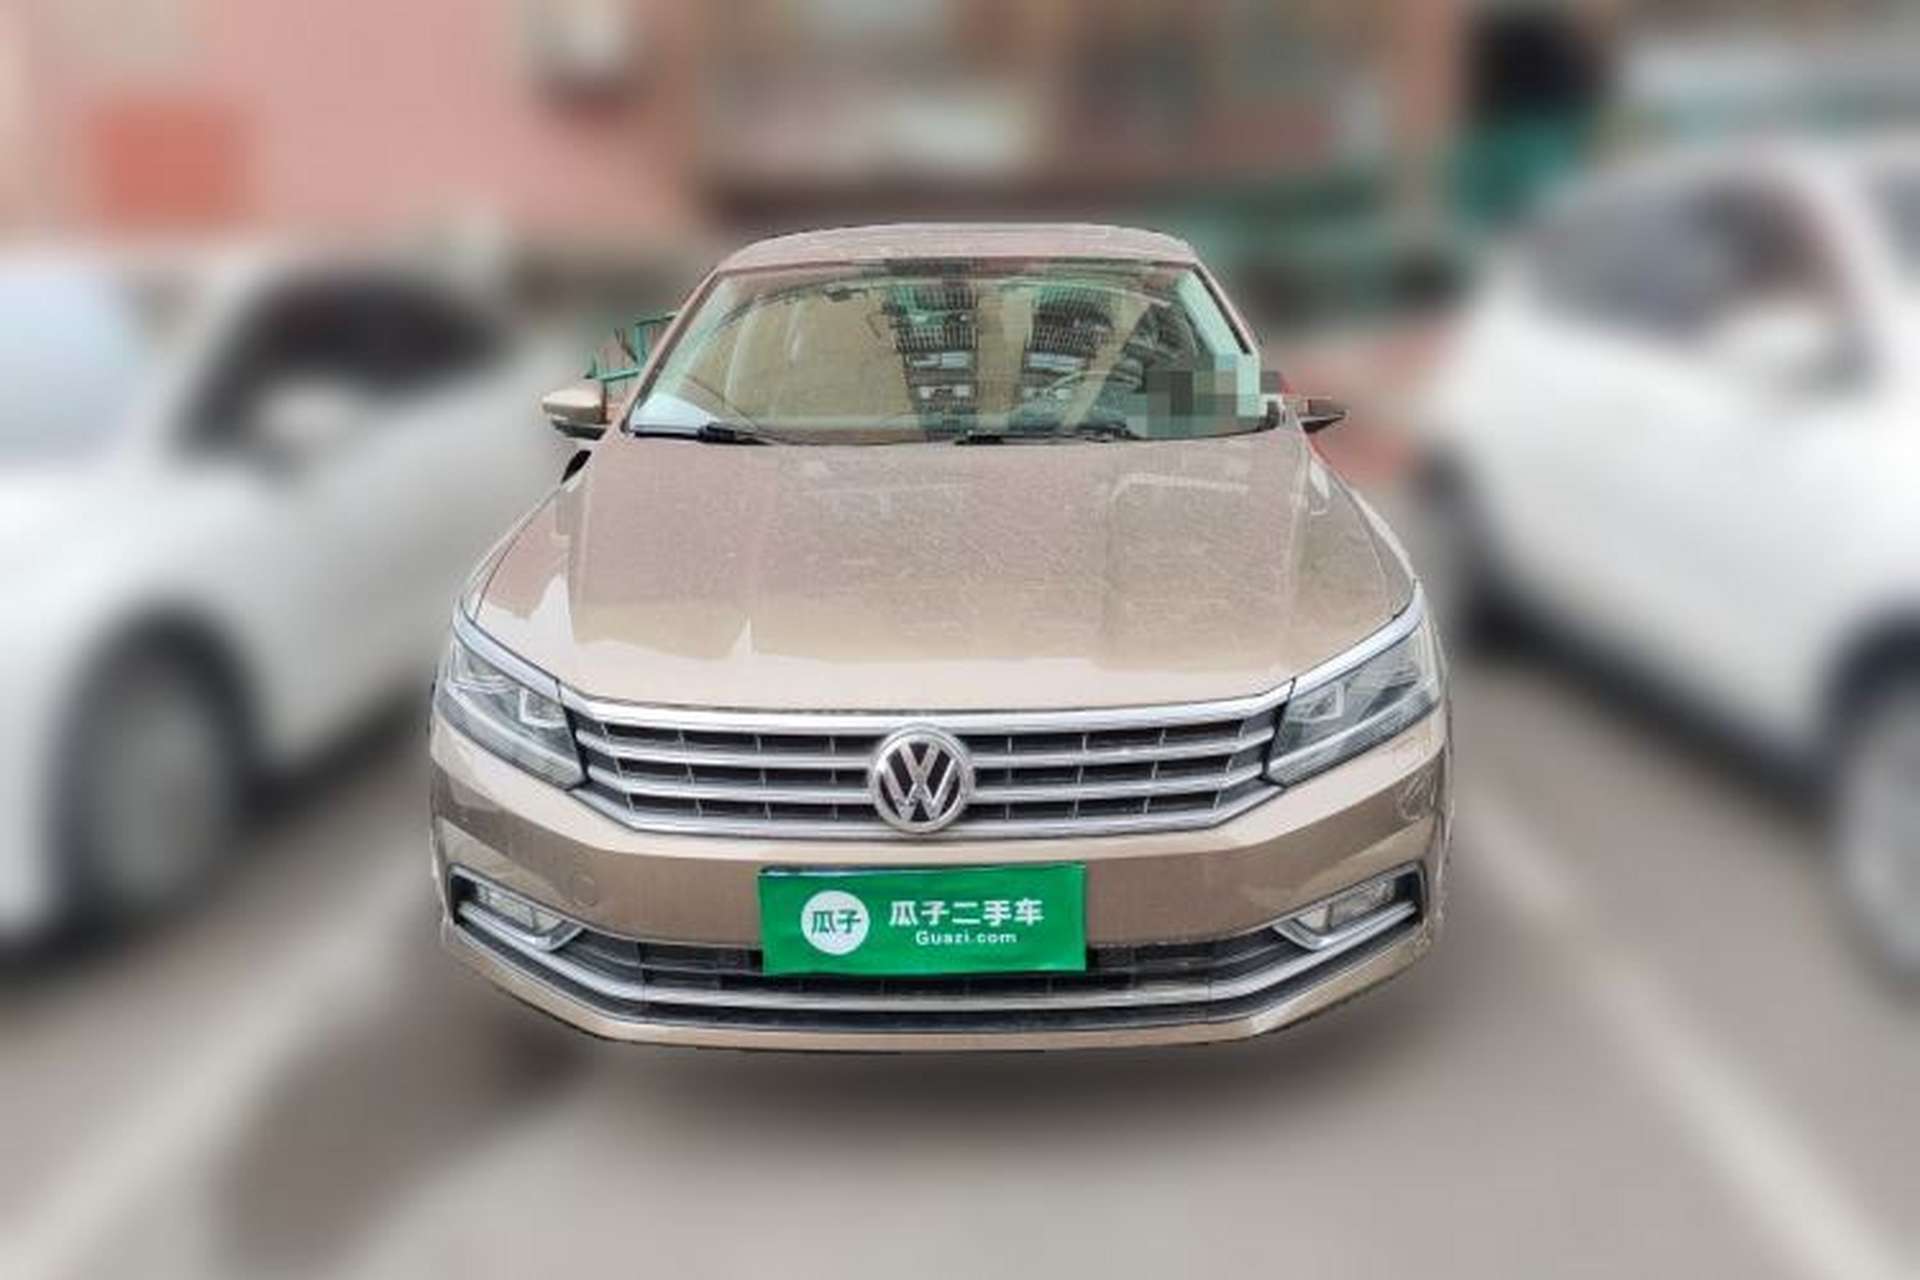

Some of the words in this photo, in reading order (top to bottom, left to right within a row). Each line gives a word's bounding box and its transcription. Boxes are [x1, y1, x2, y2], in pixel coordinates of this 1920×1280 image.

[810, 909, 861, 935] 瓜子
[888, 898, 1044, 927] 瓜子二手车
[915, 930, 1018, 945] Guazi.com
